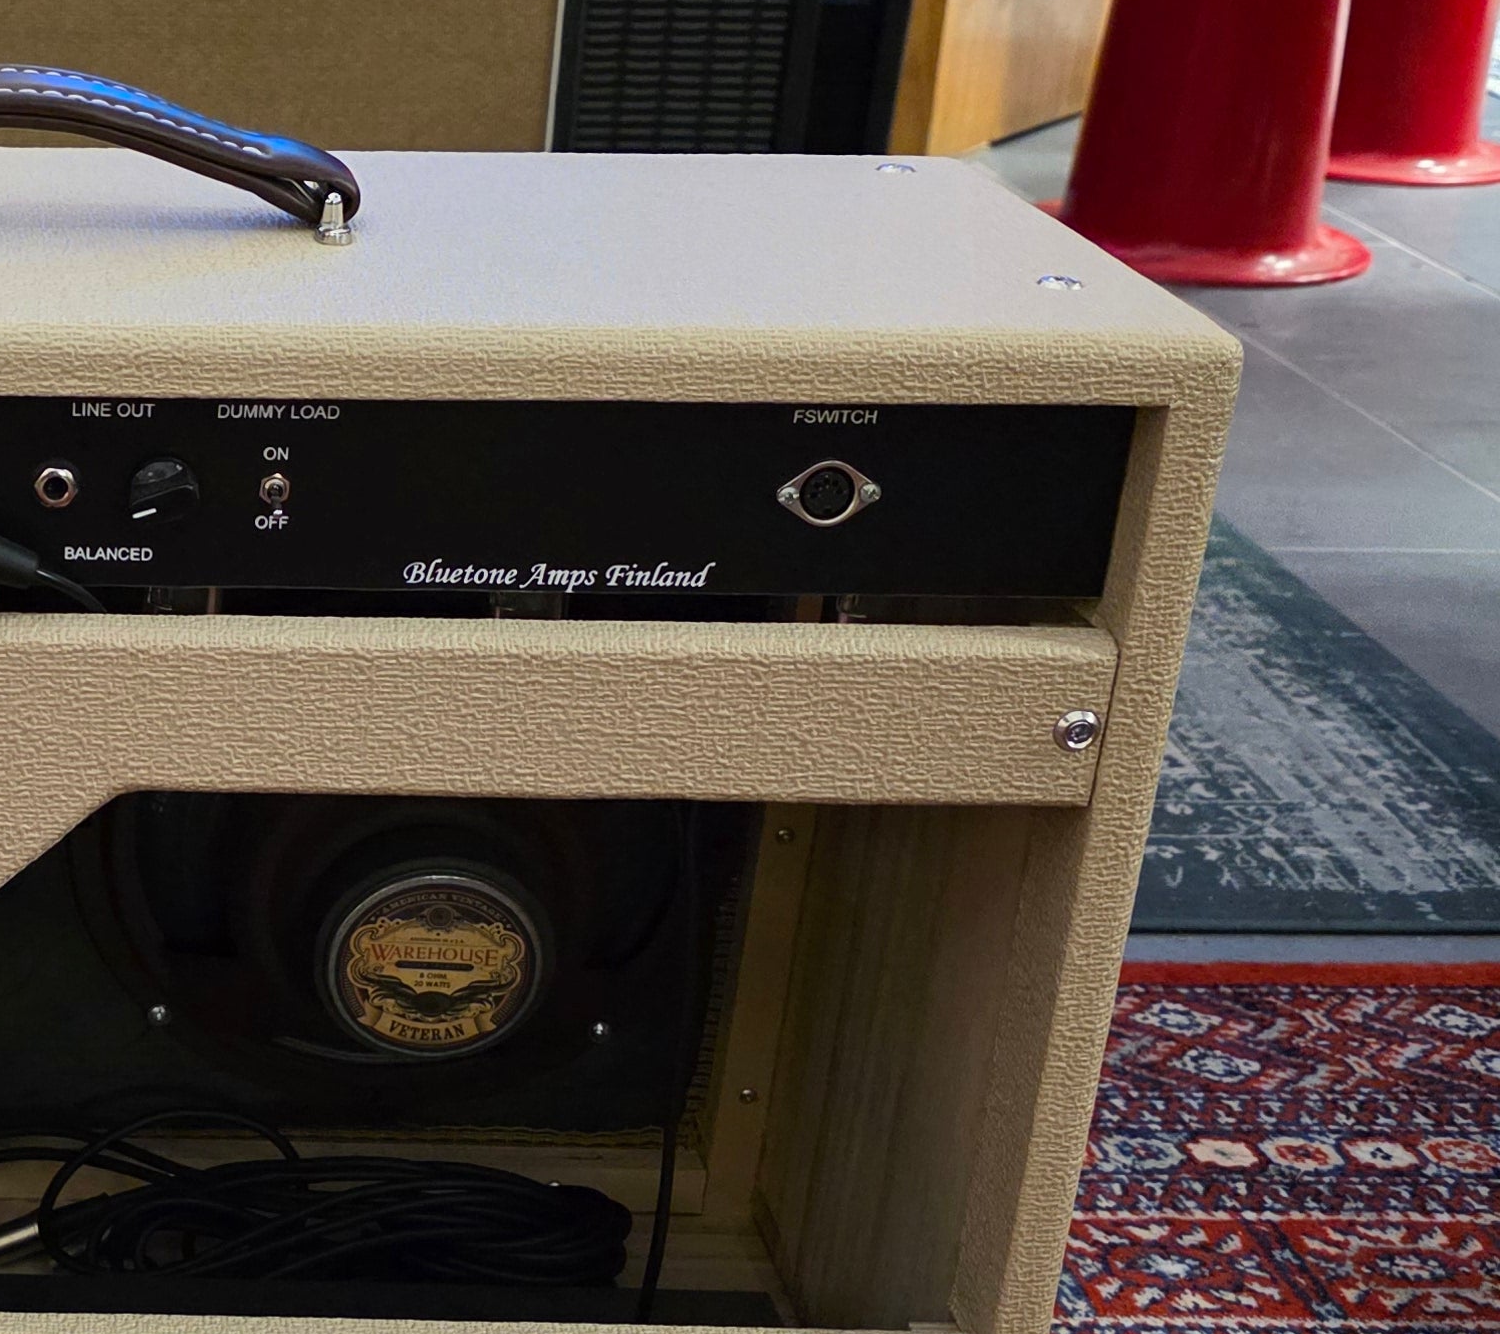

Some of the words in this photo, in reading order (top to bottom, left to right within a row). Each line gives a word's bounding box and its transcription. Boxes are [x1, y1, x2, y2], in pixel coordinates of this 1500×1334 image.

[72, 402, 111, 418] LINE
[116, 403, 156, 418] OUT
[217, 404, 286, 419] DUMMY
[291, 405, 341, 420] LOAD
[792, 409, 879, 425] FSWITCH
[262, 446, 290, 461] ON
[254, 515, 289, 530] OFF
[64, 546, 154, 562] BALANCED
[403, 558, 518, 585] Bluetone
[518, 562, 598, 593] Amps
[605, 561, 716, 588] Finland
[370, 943, 500, 967] WAREHOUSE
[426, 980, 451, 989] WATTS
[388, 1019, 465, 1041] VETERAN
